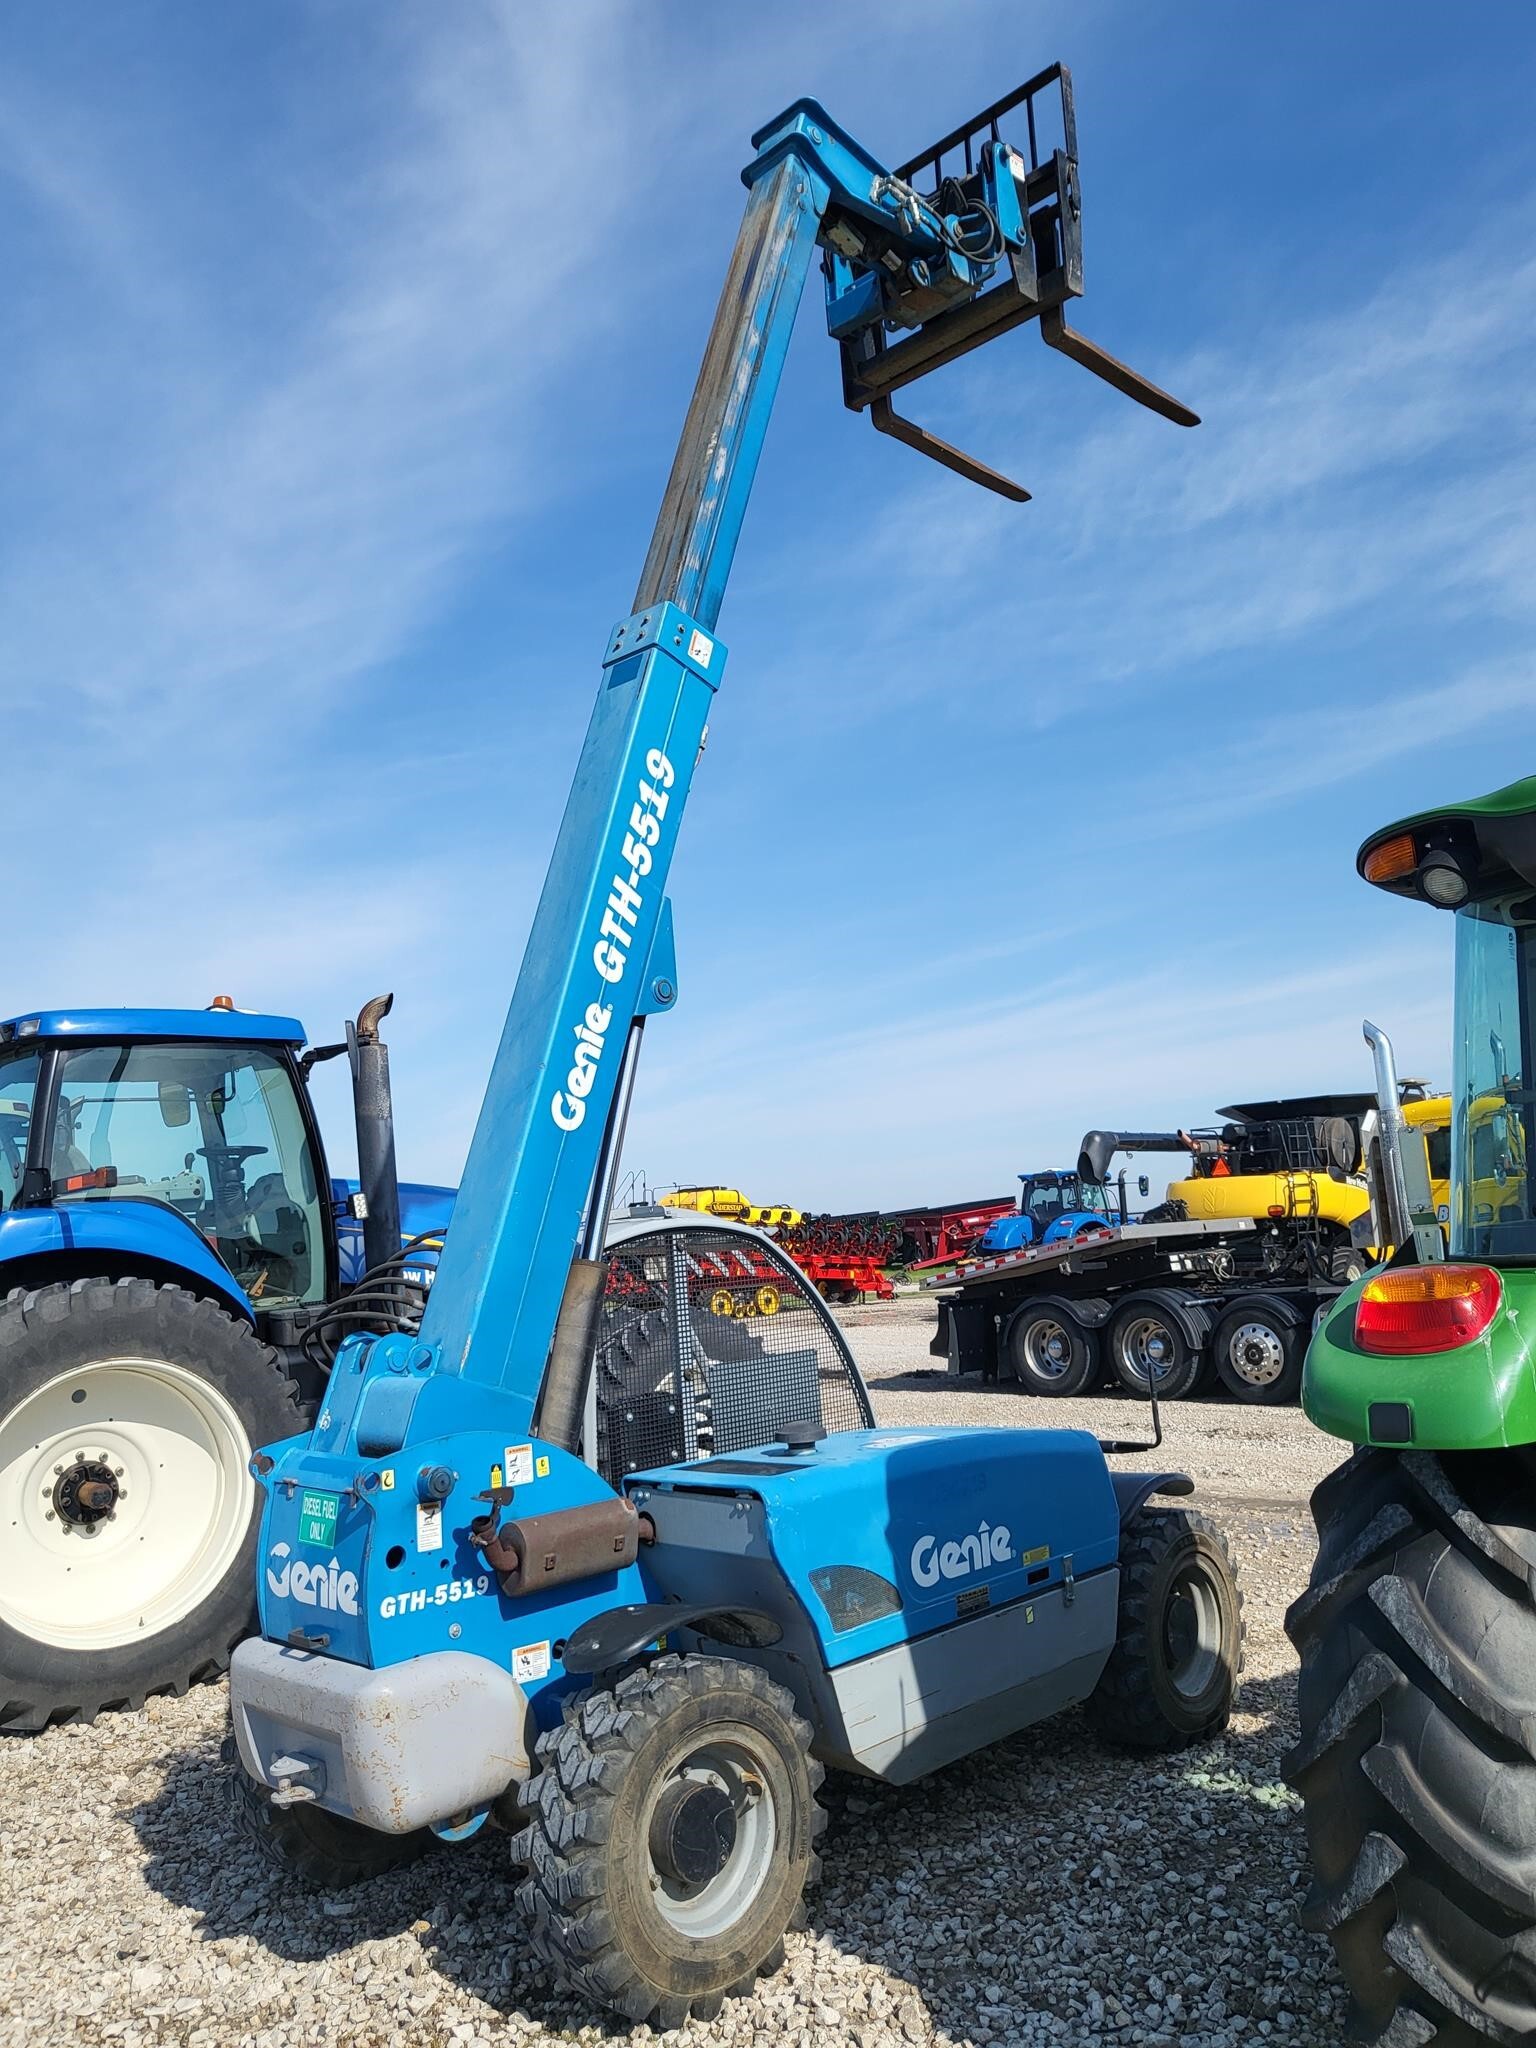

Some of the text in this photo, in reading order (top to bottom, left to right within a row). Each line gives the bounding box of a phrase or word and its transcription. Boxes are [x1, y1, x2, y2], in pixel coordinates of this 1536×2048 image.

[551, 748, 675, 1131] Genie GTH-5519
[303, 1497, 337, 1520] DIESEL FUEL
[310, 1521, 326, 1541] ONLY
[267, 1542, 359, 1616] Genie
[911, 1520, 1012, 1588] Genie
[380, 1575, 489, 1619] GTH-5519
